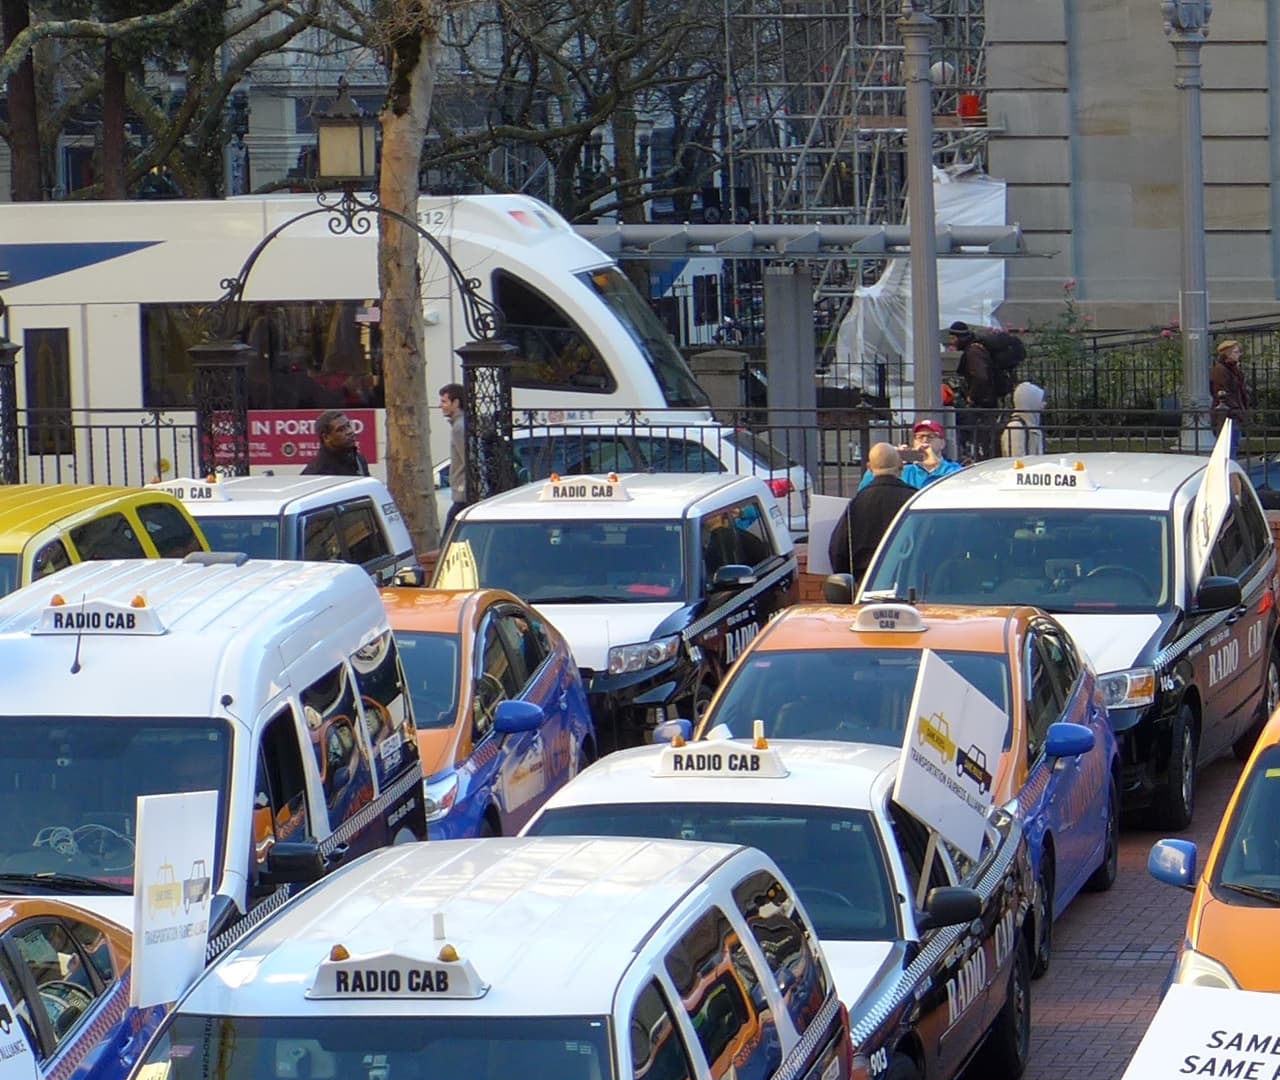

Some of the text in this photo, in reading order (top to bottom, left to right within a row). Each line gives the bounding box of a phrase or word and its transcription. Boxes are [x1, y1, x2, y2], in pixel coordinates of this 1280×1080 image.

[252, 420, 263, 435] IN
[1016, 473, 1077, 487] RADIO CAB
[190, 487, 212, 499] CAB
[553, 484, 613, 498] RADIO CAB
[54, 612, 136, 629] RADIO CAB
[873, 609, 900, 620] UNION
[879, 619, 895, 629] CAB
[1208, 638, 1239, 687] RADIO
[673, 753, 760, 772] RADIO CAB
[911, 746, 946, 785] TRANSPORTATION
[947, 776, 967, 801] FAIRNESS
[967, 793, 987, 818] ALLIANCE
[336, 969, 449, 992] RADIO CAB
[946, 946, 987, 1028] RADIO
[870, 1048, 888, 1077] 903
[1179, 1055, 1264, 1080] SAME
